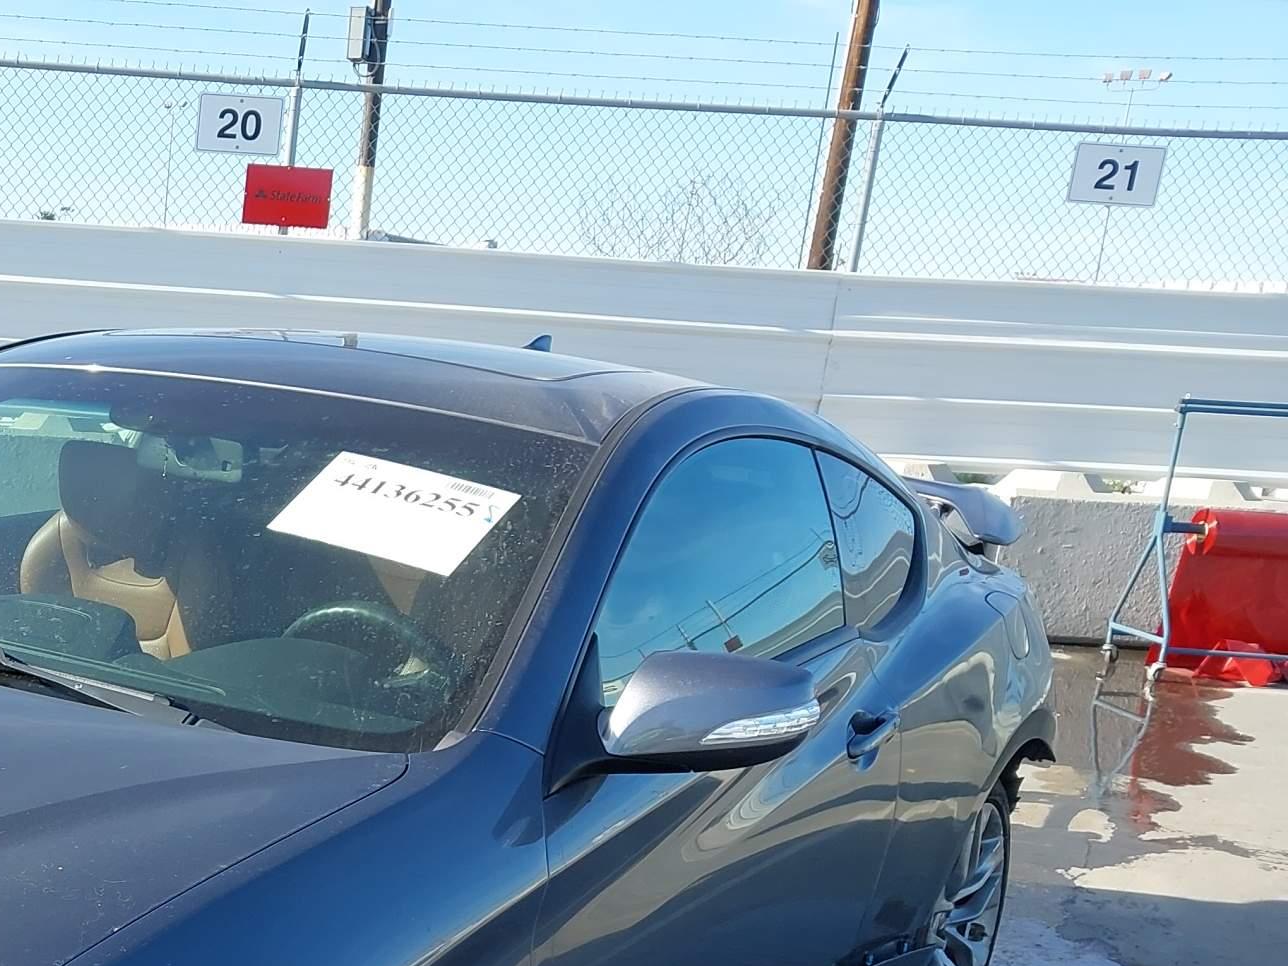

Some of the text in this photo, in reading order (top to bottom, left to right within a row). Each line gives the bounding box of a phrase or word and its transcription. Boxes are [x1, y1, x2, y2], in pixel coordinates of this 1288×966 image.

[216, 108, 262, 141] 20
[1093, 158, 1140, 192] 21
[333, 473, 481, 517] 44136255
